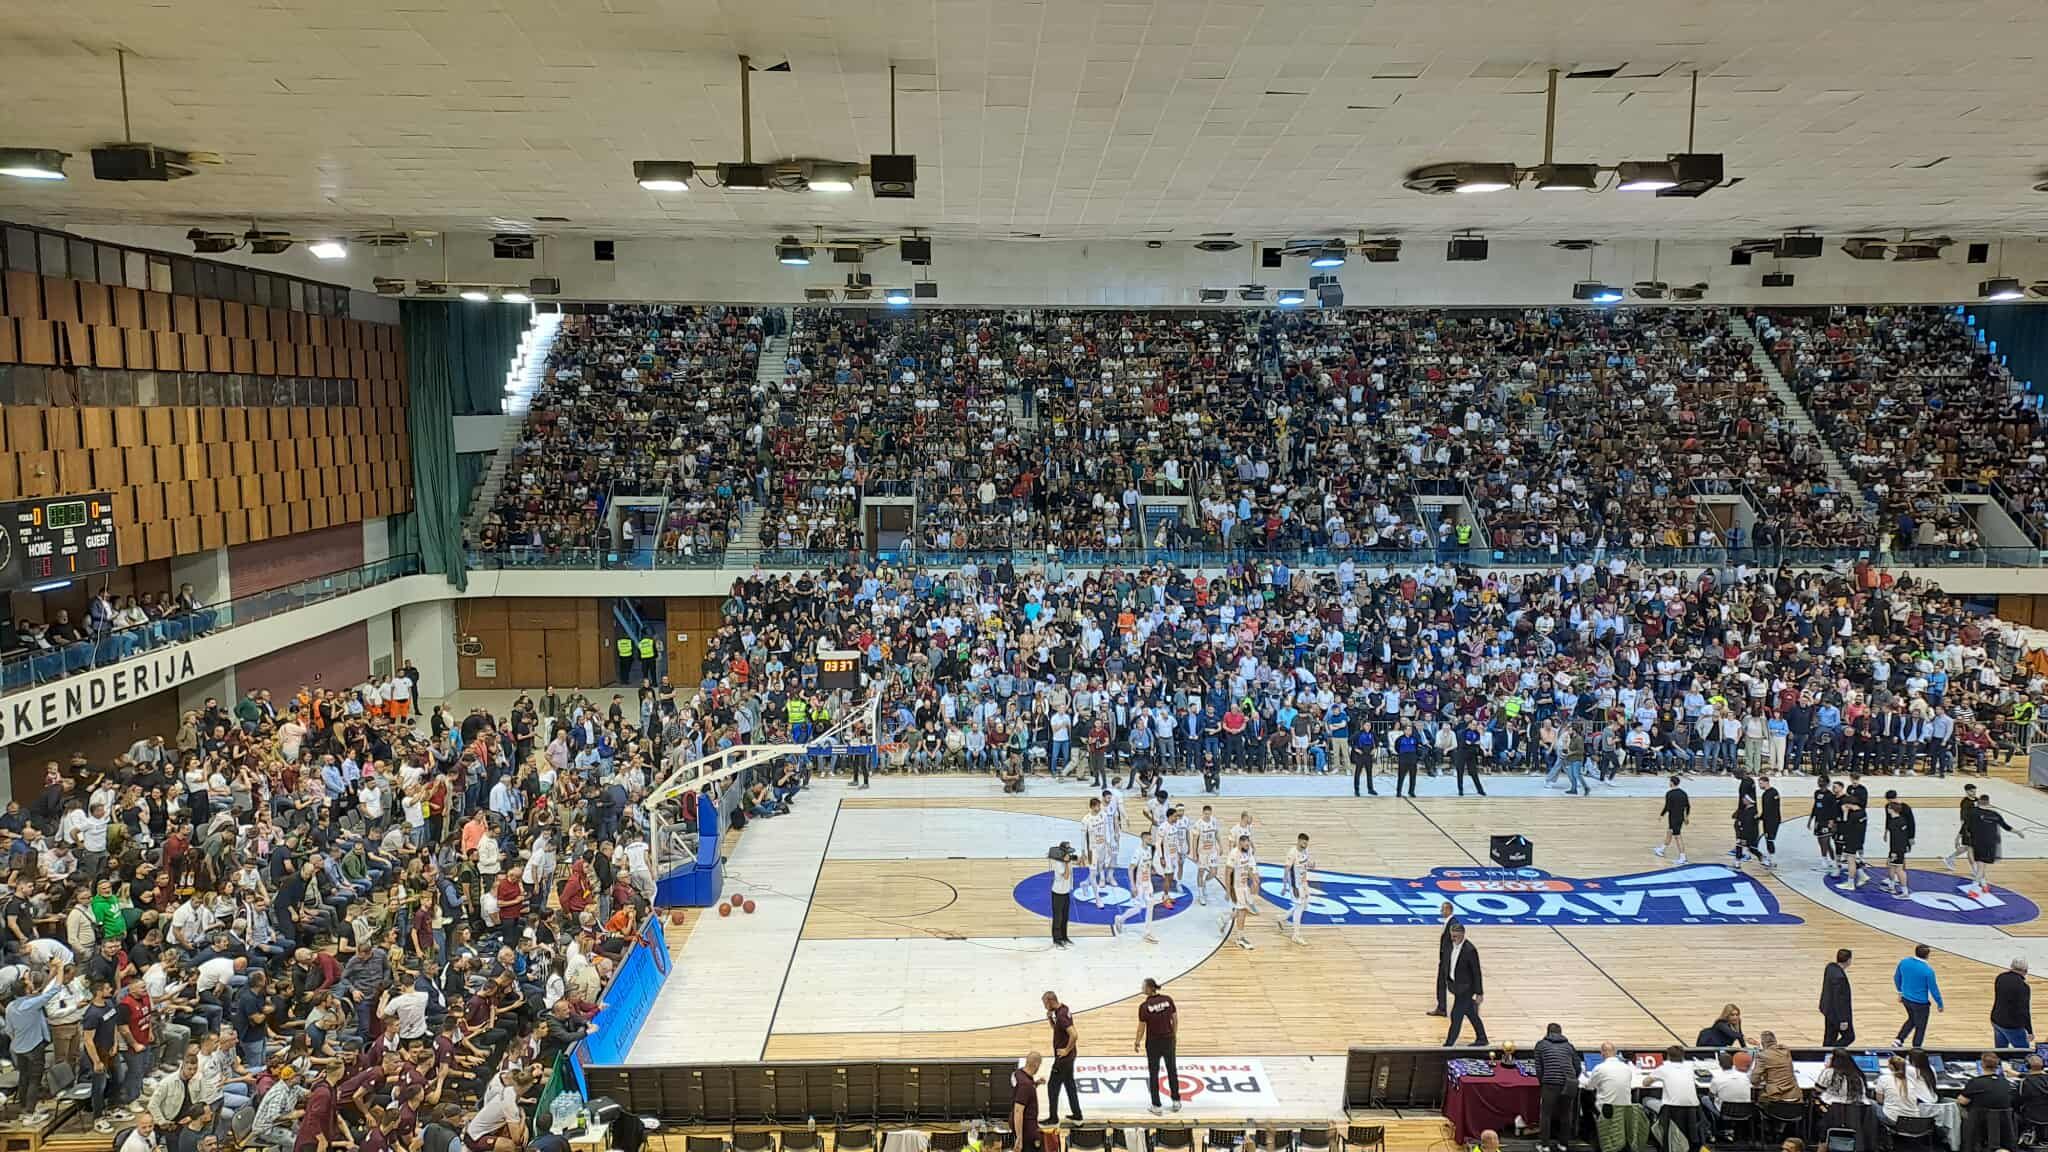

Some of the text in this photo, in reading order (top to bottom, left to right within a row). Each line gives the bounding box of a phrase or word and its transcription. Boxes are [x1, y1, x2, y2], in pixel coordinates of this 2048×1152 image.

[85, 533, 110, 548] GUEST
[28, 541, 53, 557] HOME
[1260, 881, 1769, 915] PLAYOFFS
